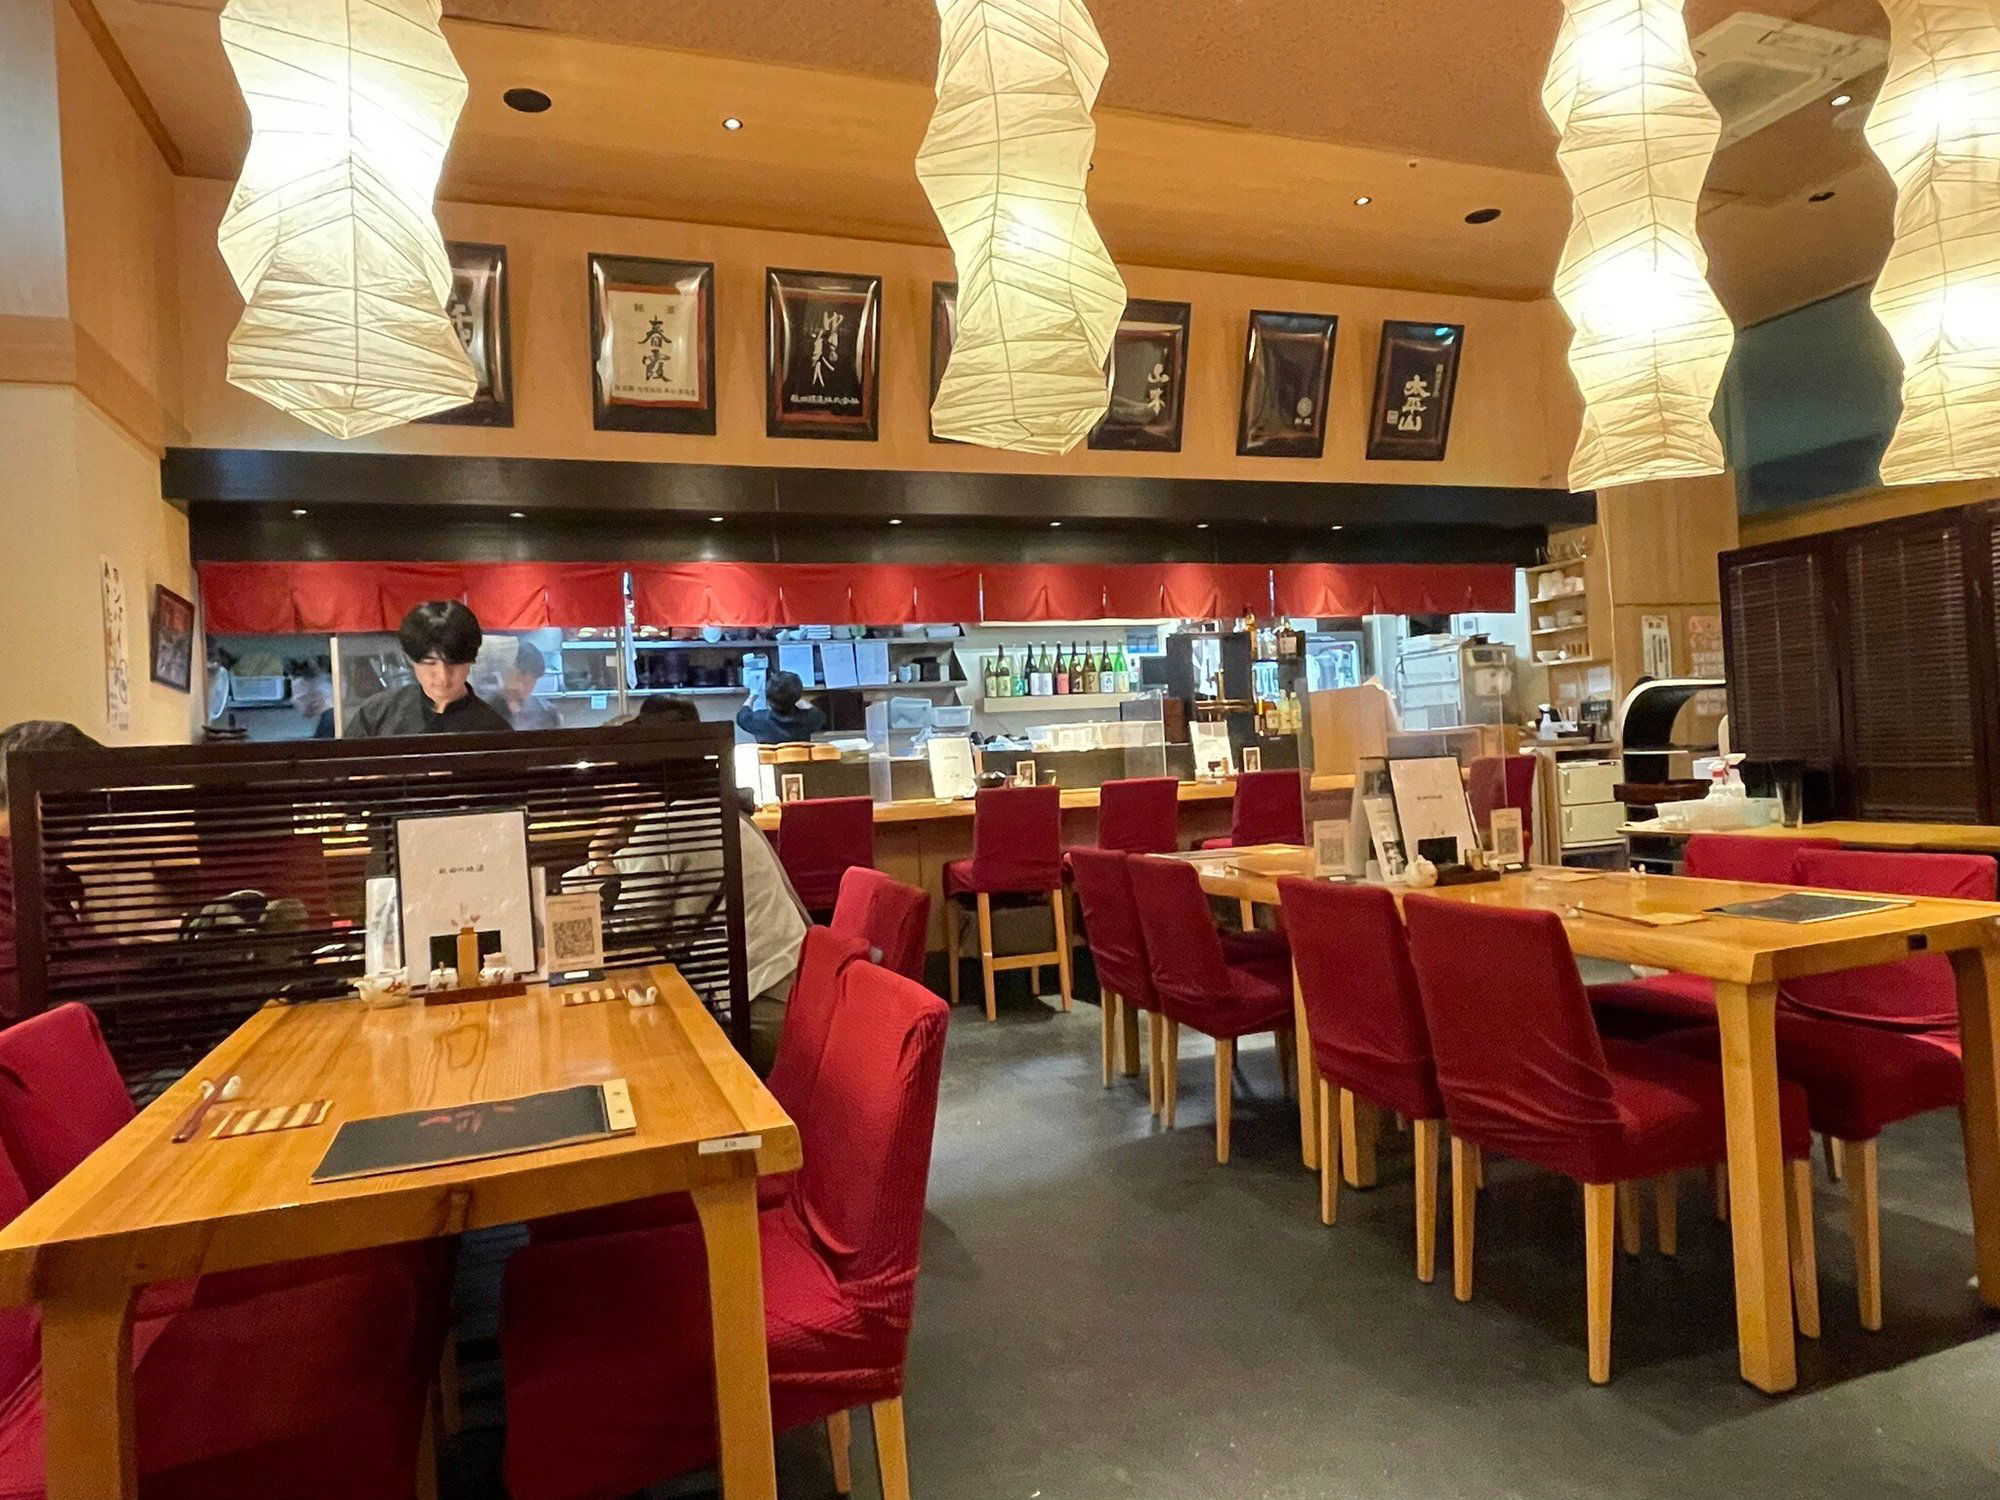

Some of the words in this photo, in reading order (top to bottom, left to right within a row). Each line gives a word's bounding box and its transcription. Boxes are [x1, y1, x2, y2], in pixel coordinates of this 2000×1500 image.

[638, 314, 672, 382] 春霞
[1398, 374, 1431, 431] 太平山
